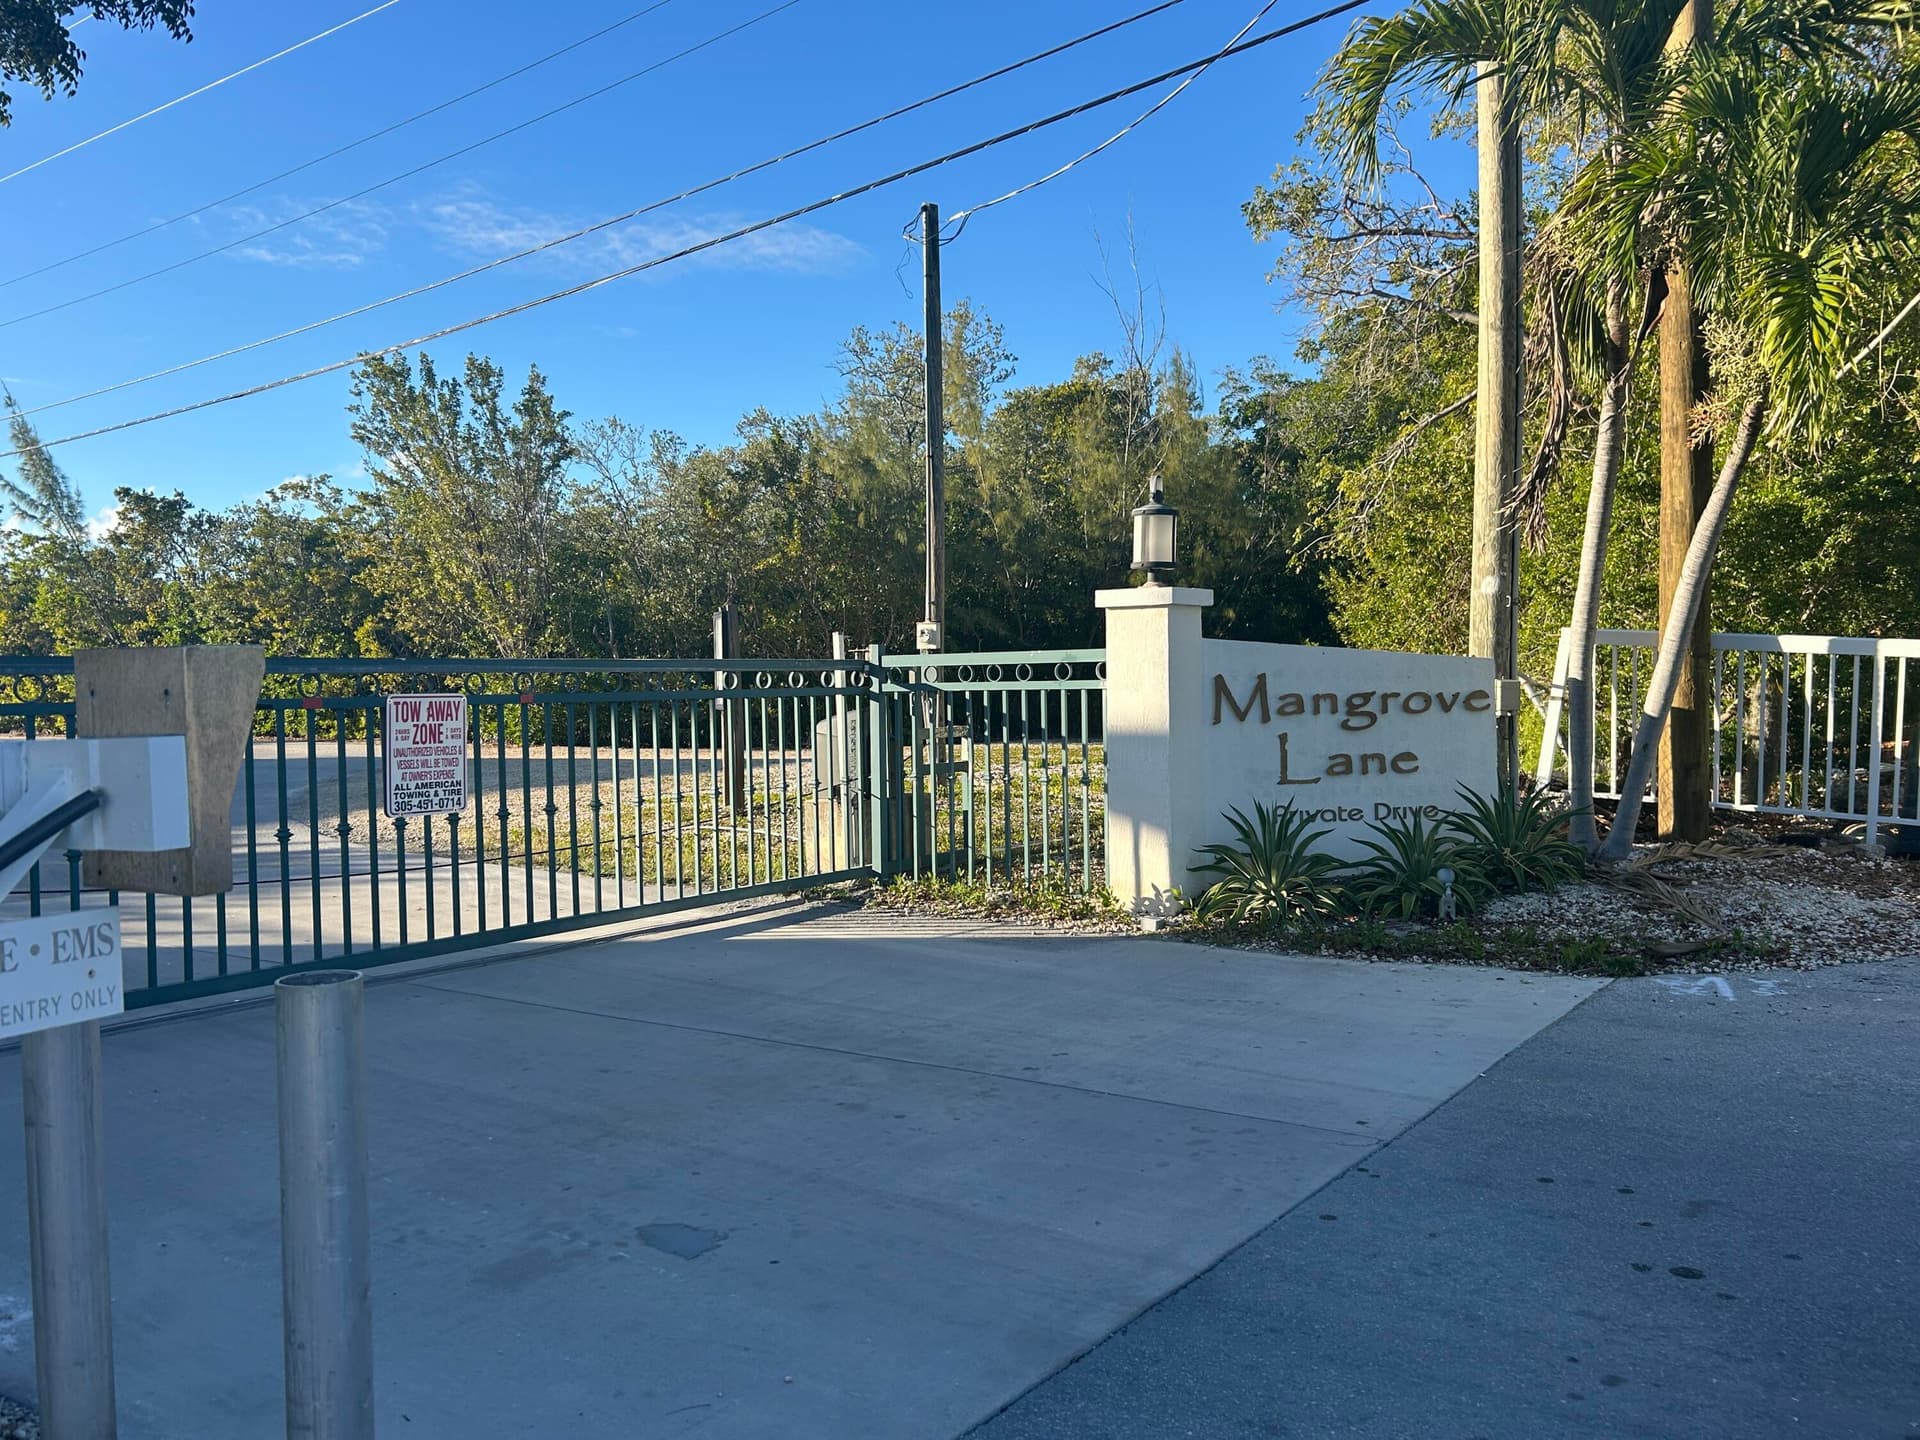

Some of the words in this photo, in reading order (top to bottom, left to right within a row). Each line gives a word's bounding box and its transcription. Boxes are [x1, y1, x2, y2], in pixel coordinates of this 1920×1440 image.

[1212, 672, 1491, 731] Mangrove
[393, 701, 421, 723] TOW
[427, 700, 460, 722] AWAY
[412, 723, 443, 745] ZONE
[393, 747, 433, 758] UNAUTHORIZED
[434, 746, 457, 756] VEHICLES
[1277, 732, 1419, 785] Lane
[397, 759, 419, 770] VESSELS
[421, 758, 433, 769] WILL
[434, 758, 440, 768] BE
[441, 757, 459, 768] TOWED
[401, 772, 408, 782] AT
[434, 769, 455, 780] EXPENSE
[393, 790, 431, 800] TOWING
[433, 790, 439, 798] &
[442, 788, 462, 797] TIRE
[394, 783, 411, 792] ALL
[414, 780, 461, 790] AMERICAN
[394, 797, 461, 812] 305-451-0714
[1374, 802, 1439, 821] Drive
[51, 921, 114, 965] EMS
[0, 994, 62, 1027] ENTRY
[71, 984, 116, 1011] ONLY
